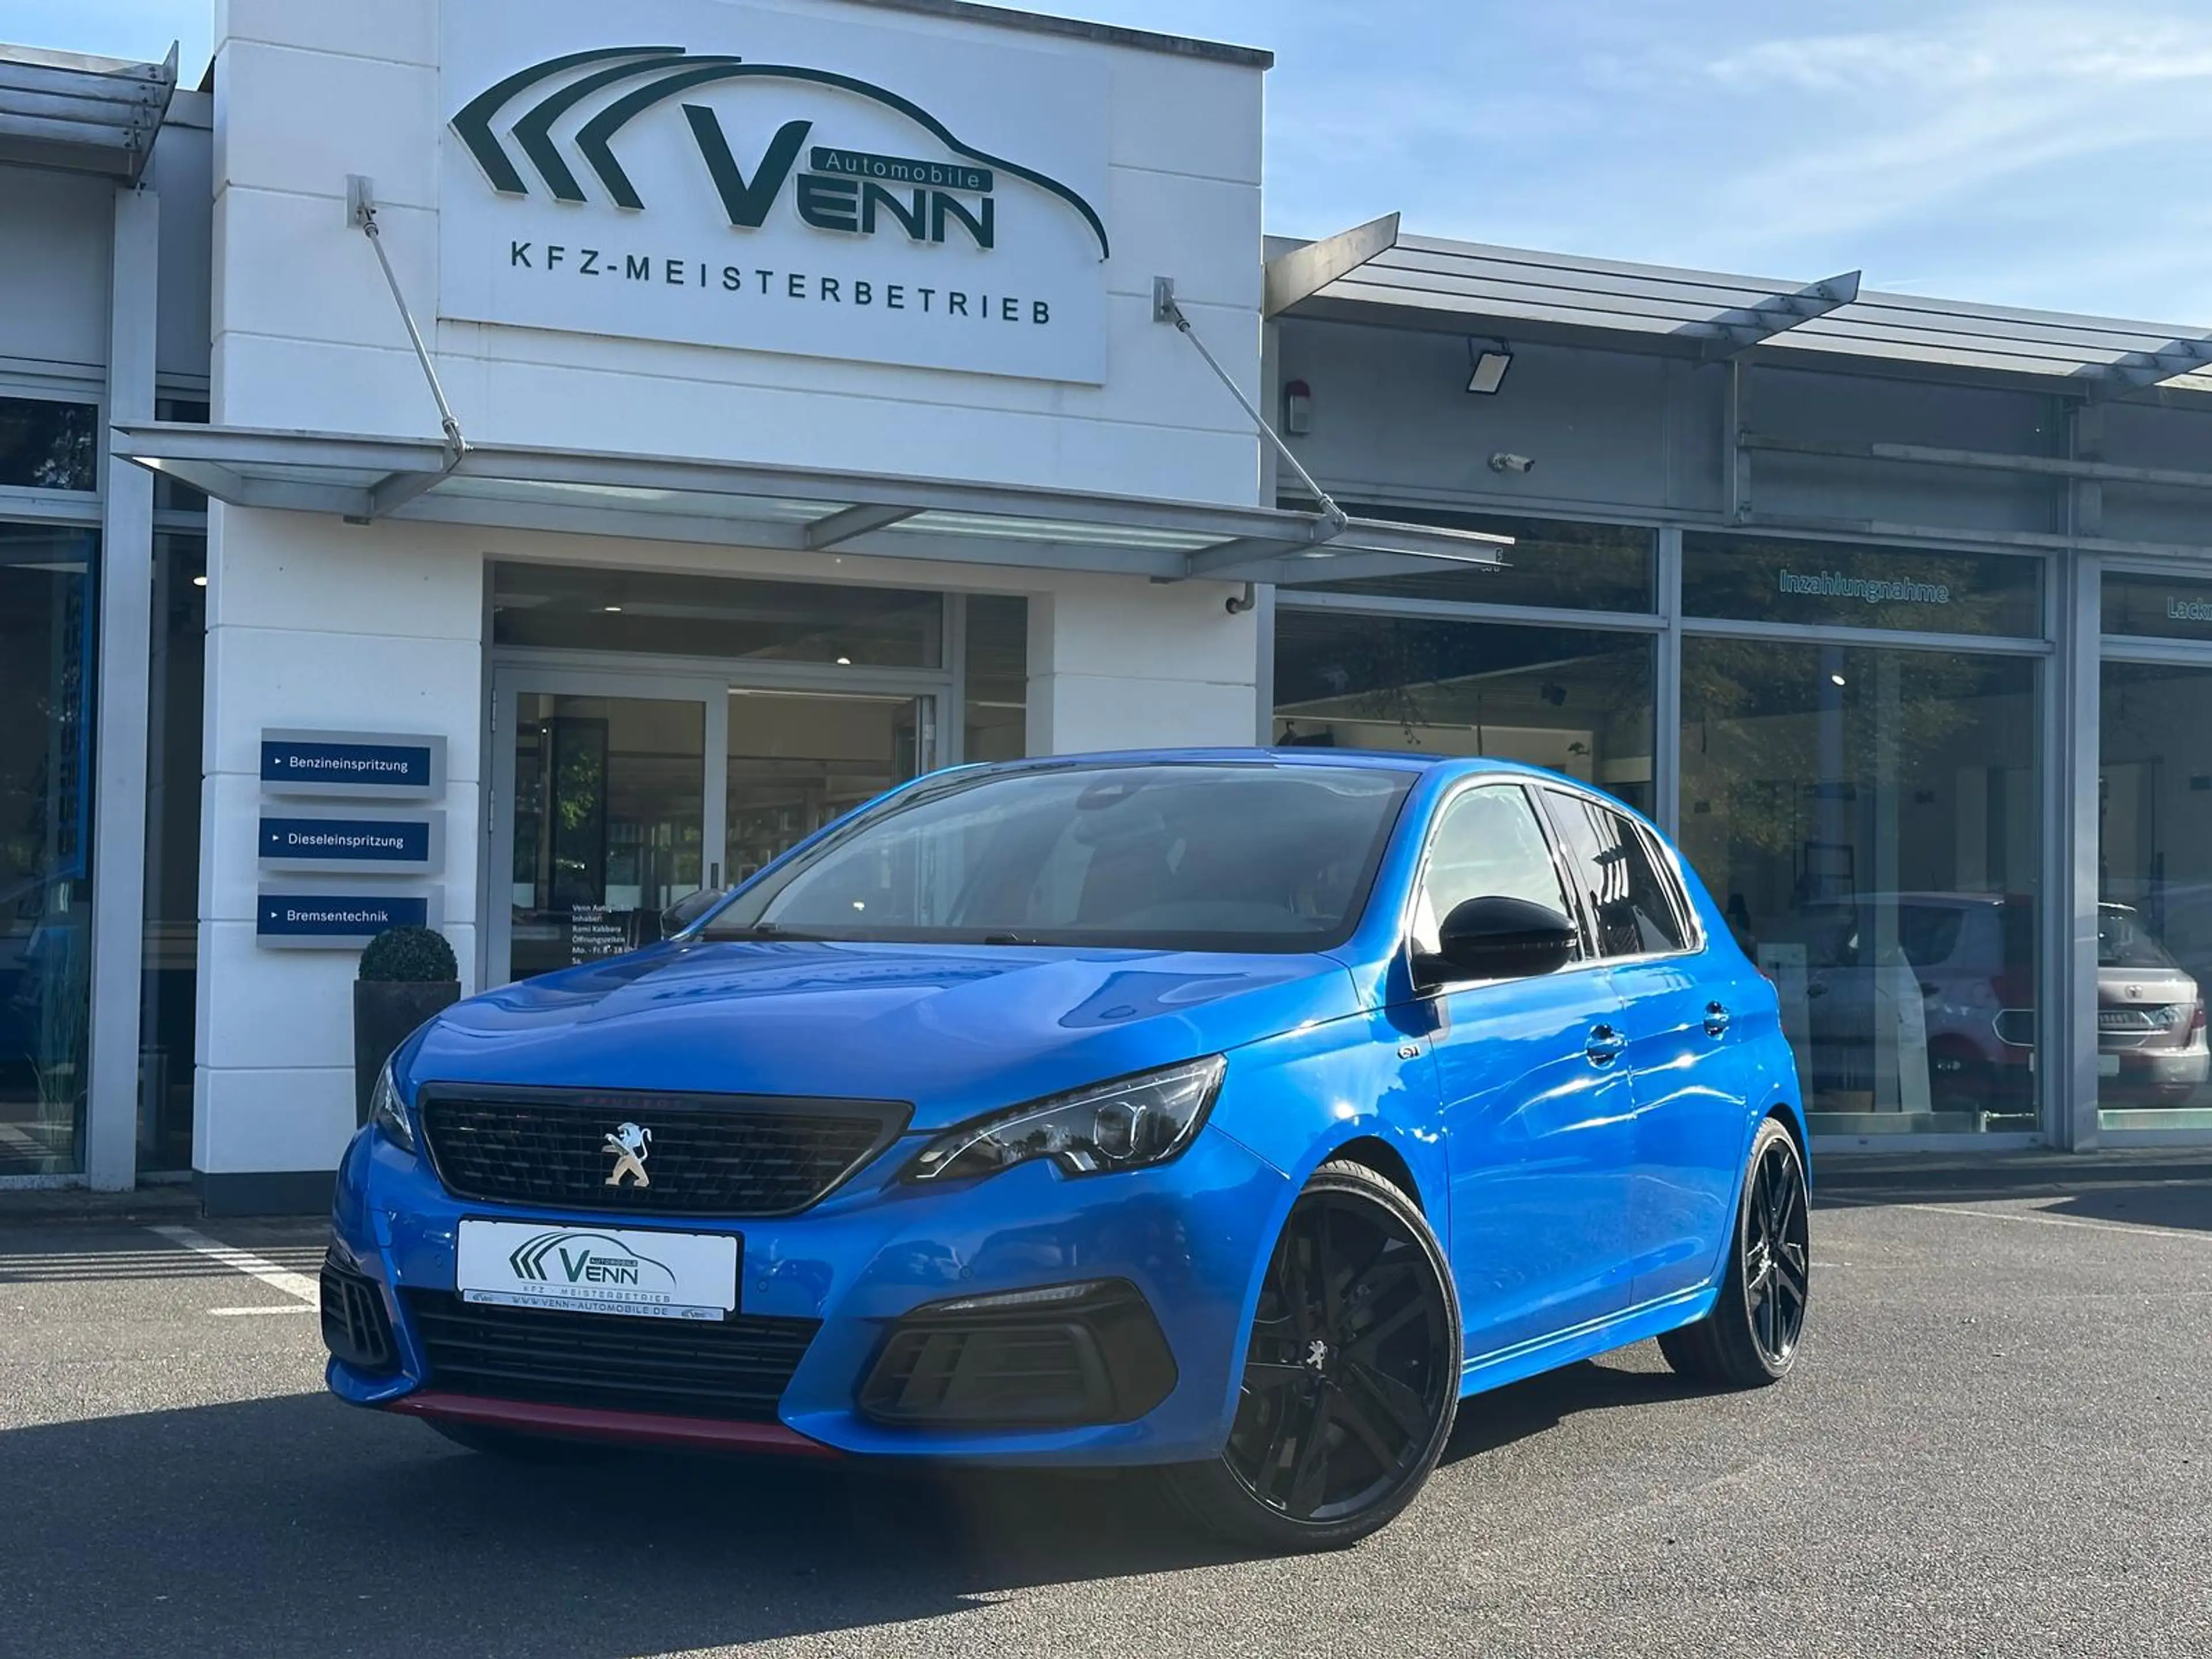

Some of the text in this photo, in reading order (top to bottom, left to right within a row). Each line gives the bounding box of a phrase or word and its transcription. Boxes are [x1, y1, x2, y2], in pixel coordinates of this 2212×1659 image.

[681, 103, 994, 248] VENN
[825, 151, 980, 188] Automobile
[511, 240, 1050, 324] KFZ-MEISTERBETRIEB
[1779, 569, 1949, 603] Inzahlungnahme
[289, 756, 408, 773] Benzineinspritzung
[288, 833, 404, 850] Dieseleinspritzung
[287, 910, 389, 923] Bremsentechnik
[559, 1248, 638, 1285] VENN
